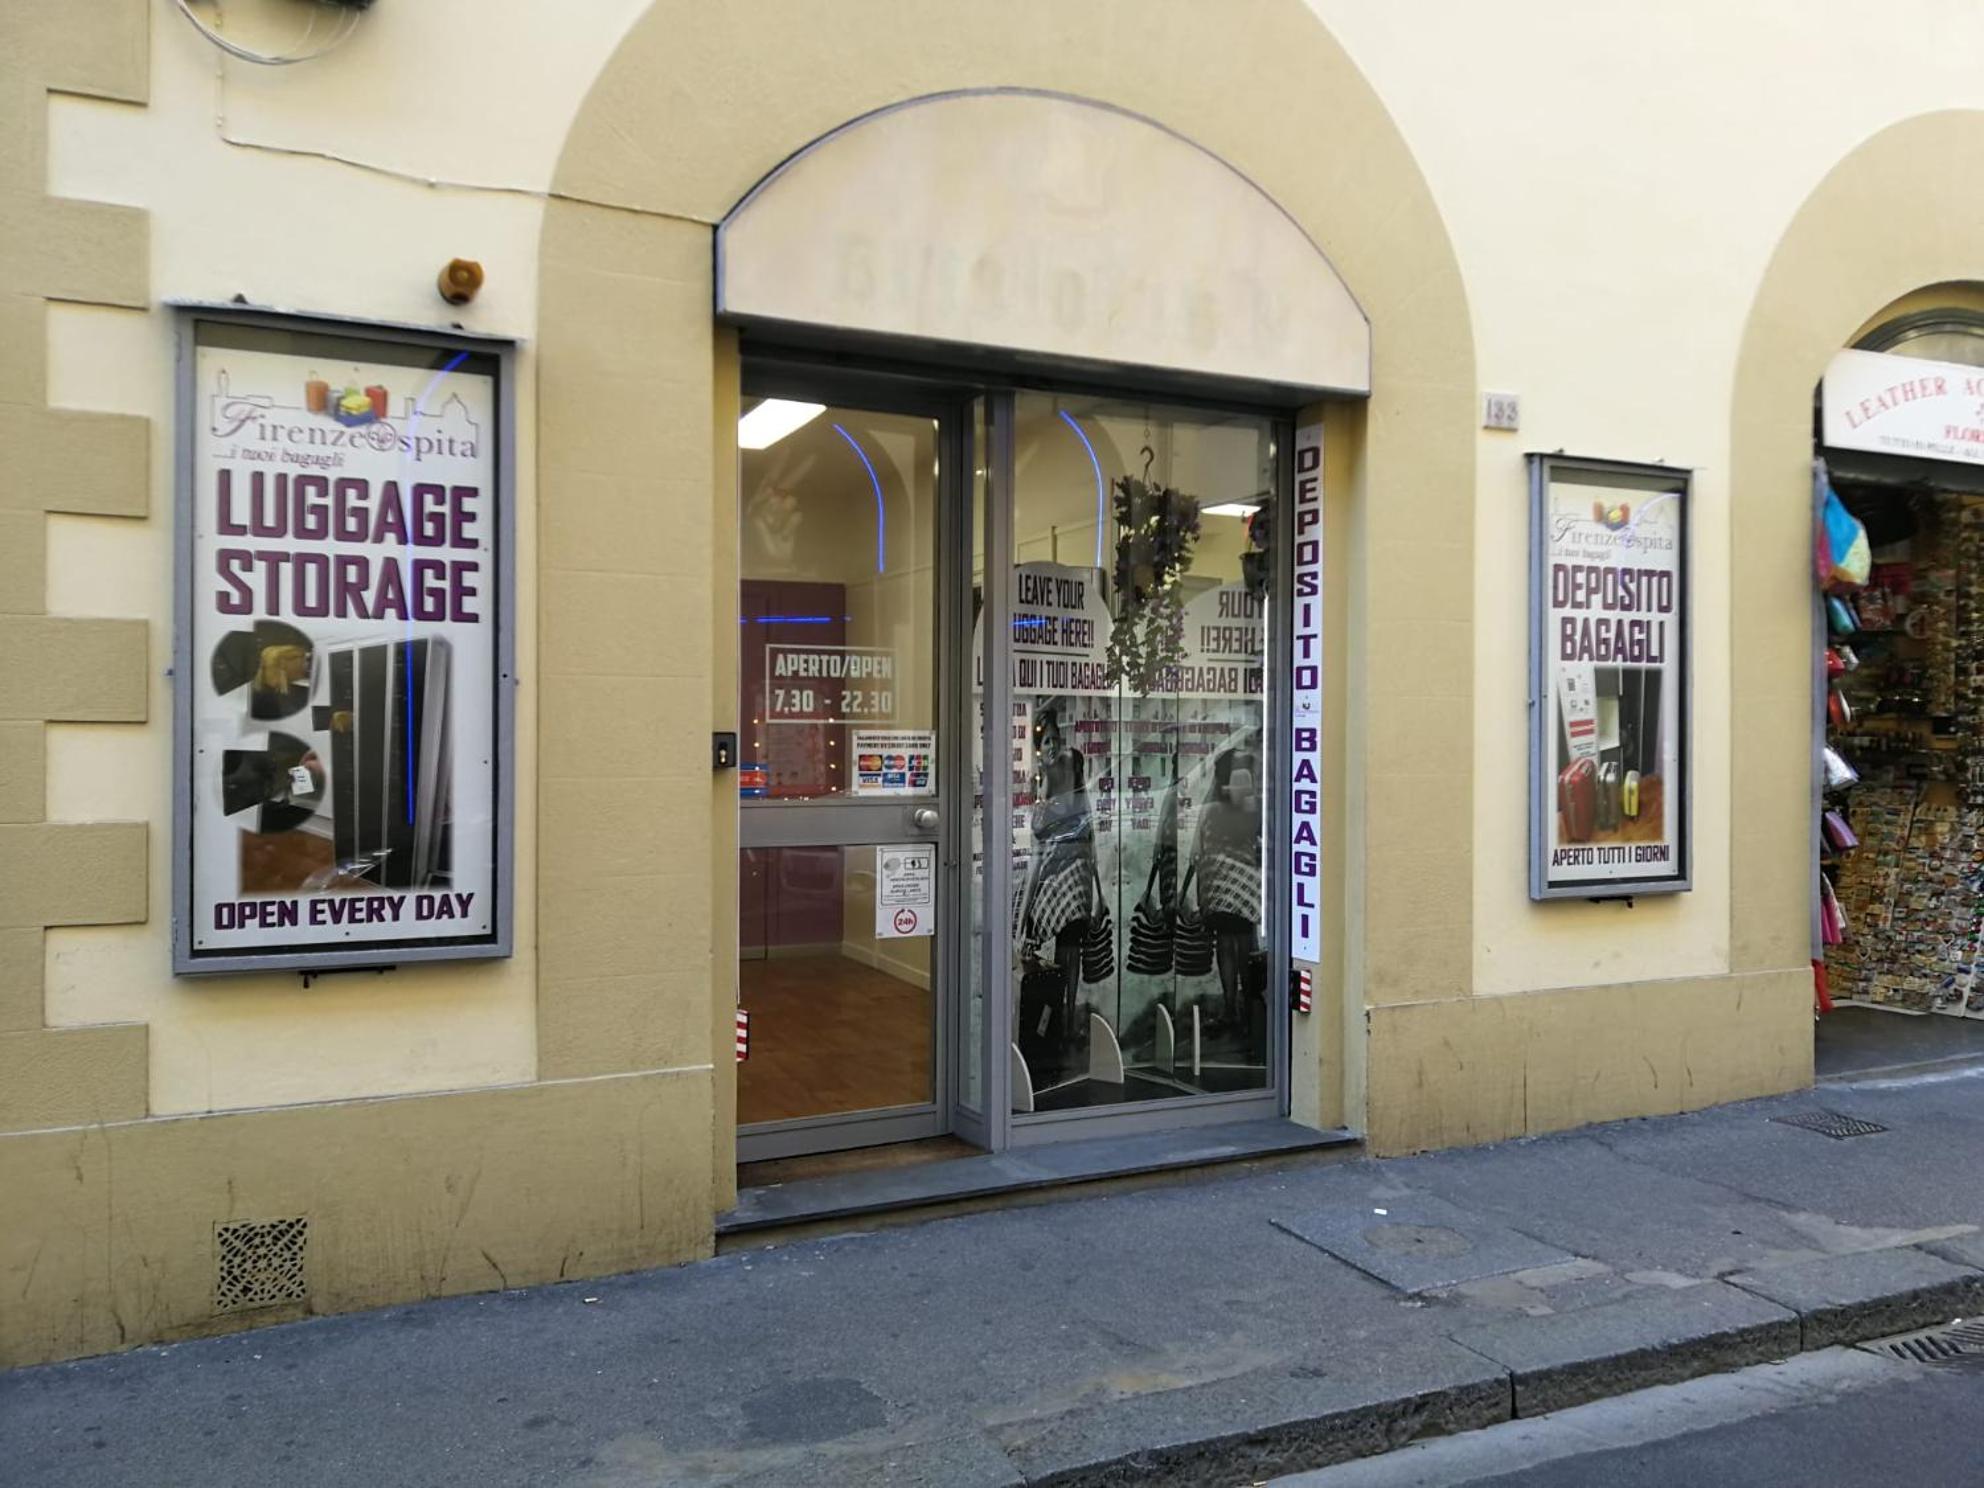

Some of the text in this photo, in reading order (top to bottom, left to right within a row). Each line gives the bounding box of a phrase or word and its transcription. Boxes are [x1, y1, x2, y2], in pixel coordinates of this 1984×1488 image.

[1844, 376, 1948, 429] LEATHER
[215, 468, 480, 549] LUGGAGE
[215, 548, 480, 623] STORAGE
[1296, 446, 1320, 690] DEPOSITO
[1552, 564, 1673, 613] DEPOSITO
[1019, 573, 1084, 610] LEAVE YOUR
[1013, 613, 1094, 648] UGGAGE HERE!!
[1560, 616, 1665, 663] BAGAGLI
[775, 654, 892, 678] APERTO/OPEN
[1019, 659, 1037, 687] QUI
[1040, 660, 1043, 687] I
[1046, 661, 1068, 688] TUOI
[1071, 662, 1109, 690] BAGAGL
[841, 691, 892, 713] 22.30
[1293, 728, 1318, 938] BAGAGLI
[1552, 845, 1670, 867] APERTO TUTTI I GIORNI
[214, 892, 475, 930] OPEN EVERY DAY
